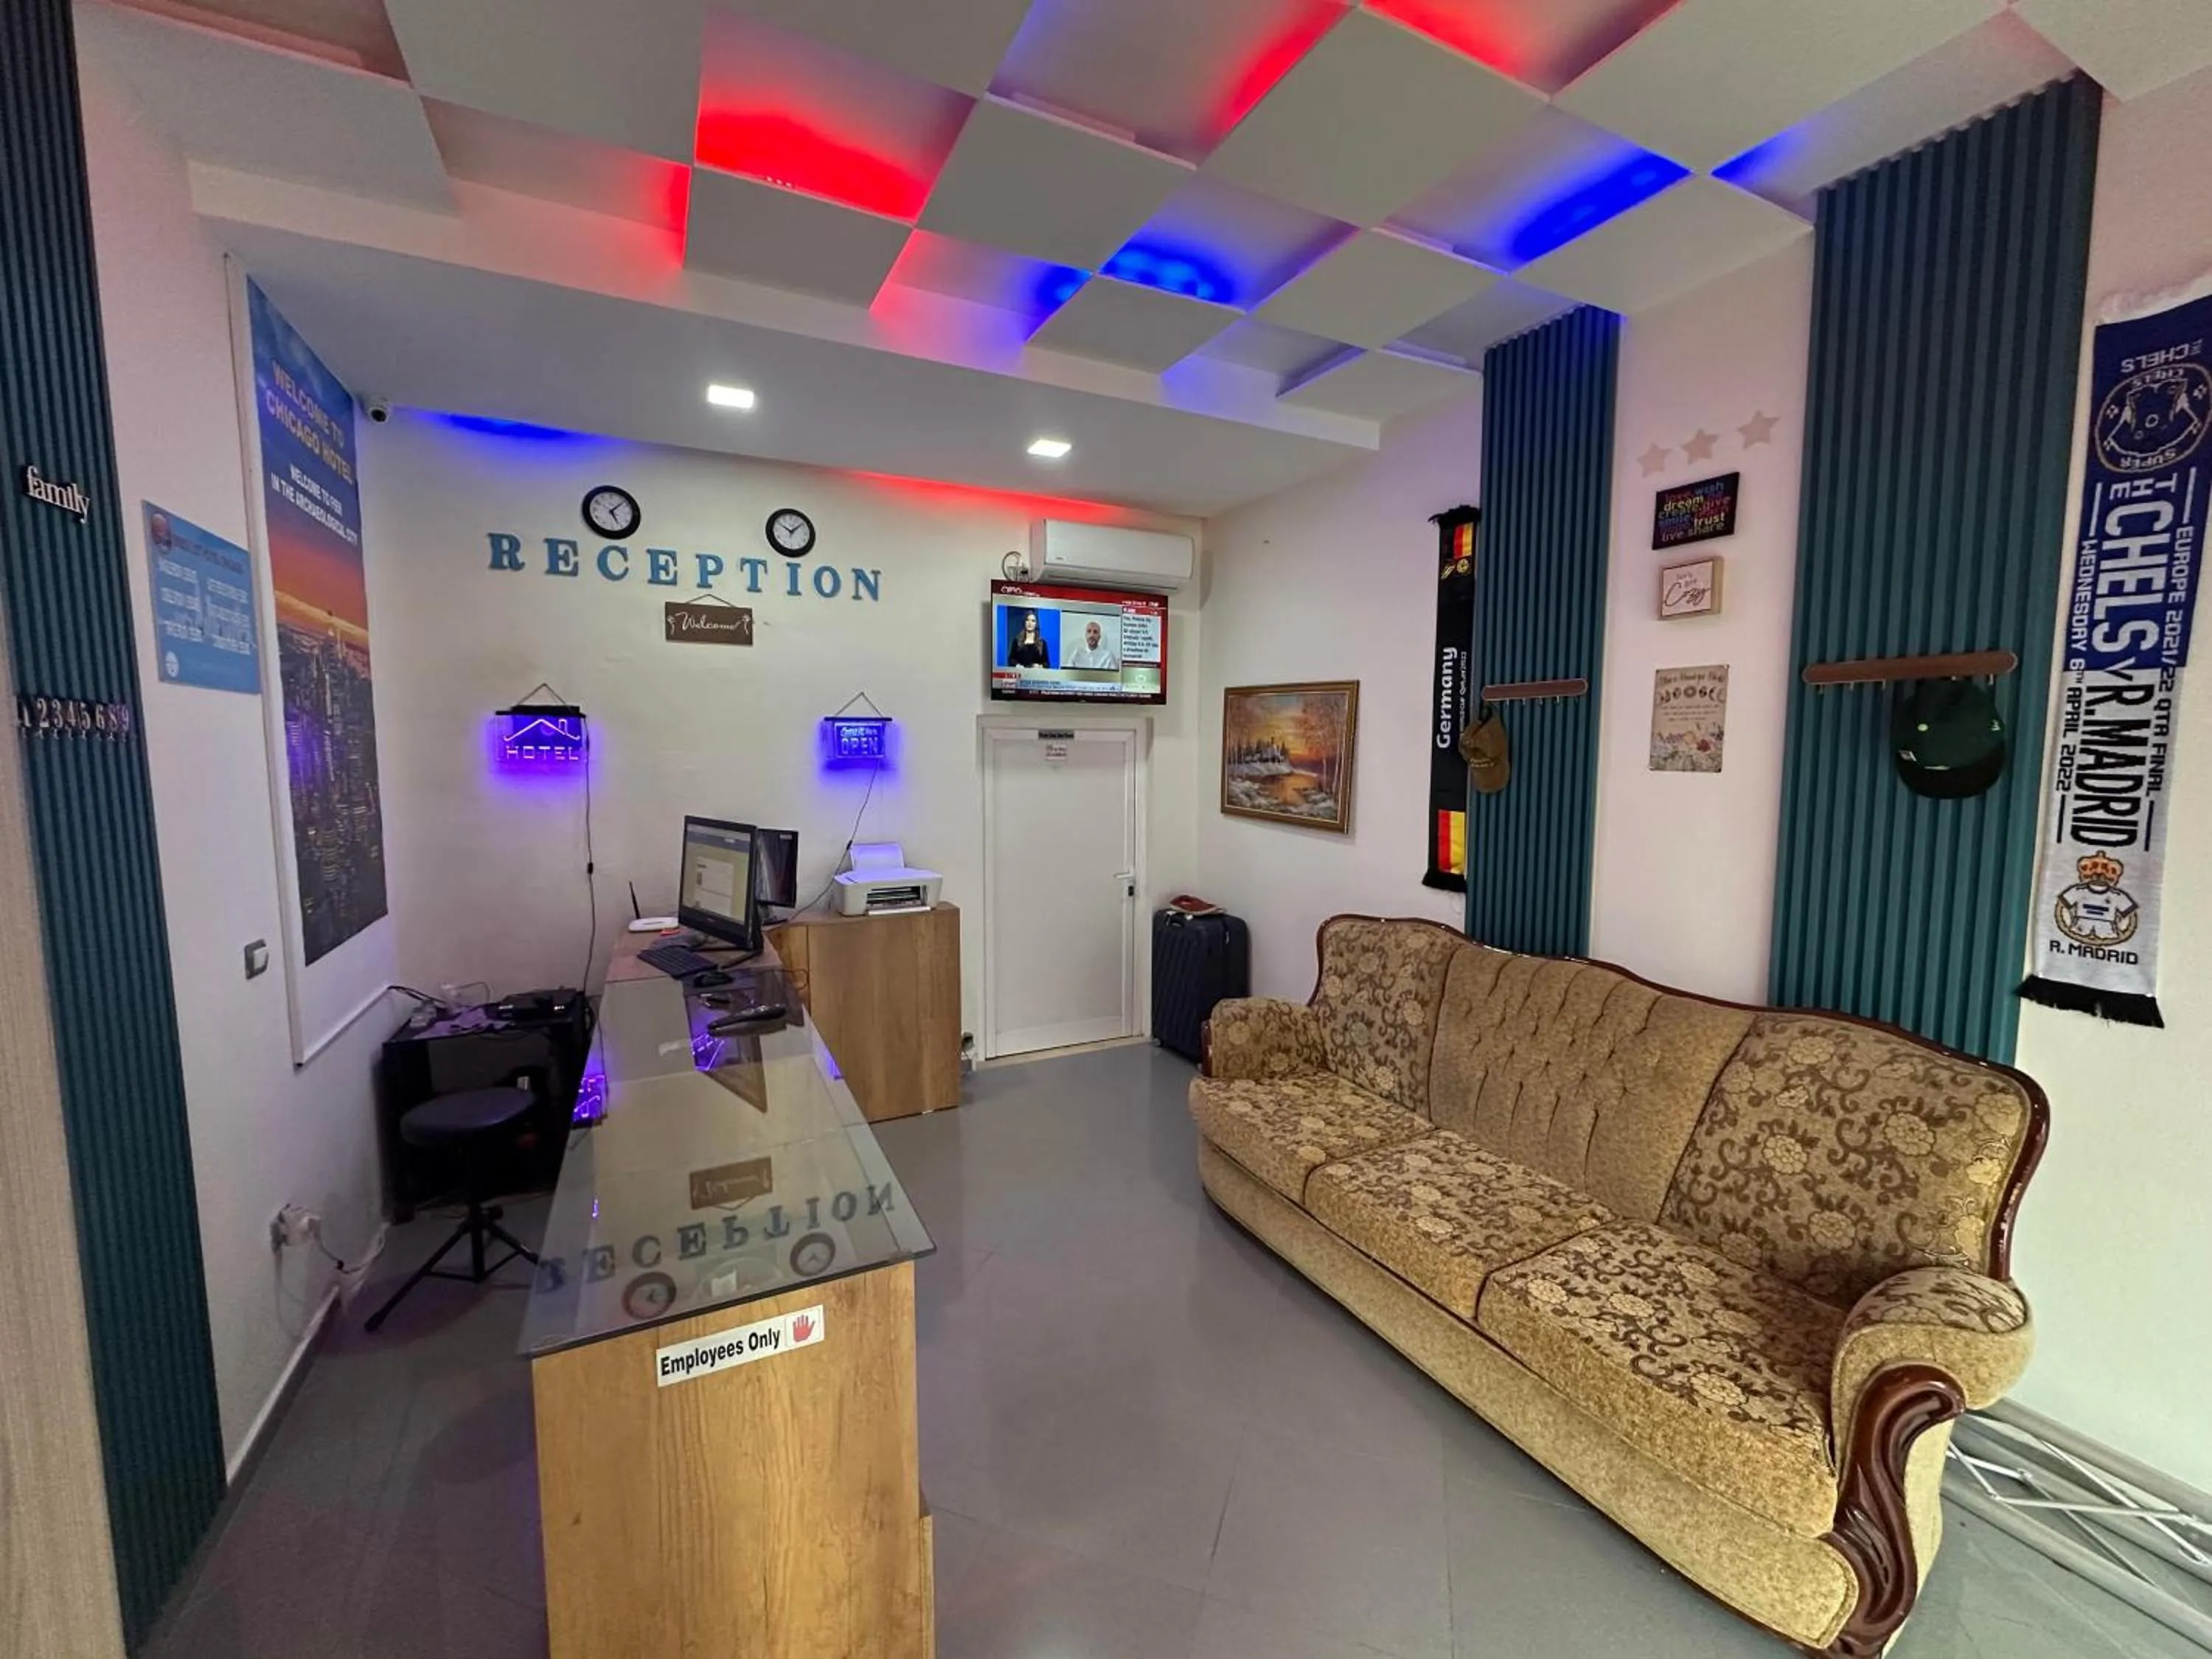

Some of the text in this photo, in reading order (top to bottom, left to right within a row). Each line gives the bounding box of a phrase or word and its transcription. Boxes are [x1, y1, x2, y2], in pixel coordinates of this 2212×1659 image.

[2121, 343, 2191, 373] CHELS
[272, 359, 330, 435] WELCOME
[265, 389, 353, 486] CHICAGO HOTEL
[2120, 448, 2177, 468] SUPER
[27, 465, 90, 524] family
[1663, 495, 1704, 512] dream
[2110, 473, 2179, 500] THE
[1661, 530, 1685, 542] live
[1694, 512, 1725, 526] trust
[487, 532, 881, 601] RECEPTION
[2091, 500, 2174, 653] CHELS
[2070, 539, 2098, 652] WEDNESDAY
[675, 611, 742, 631] Welcome
[2146, 526, 2194, 797] EUROPE 2021/22 QTR FINAL
[1435, 646, 1458, 749] Germany
[2063, 686, 2083, 739] APRIL
[506, 745, 579, 760] HOTEL
[841, 737, 878, 755] OPEN
[2056, 745, 2076, 792] 2022
[2068, 942, 2138, 965] MADRID
[660, 1327, 781, 1377] Employees Only
